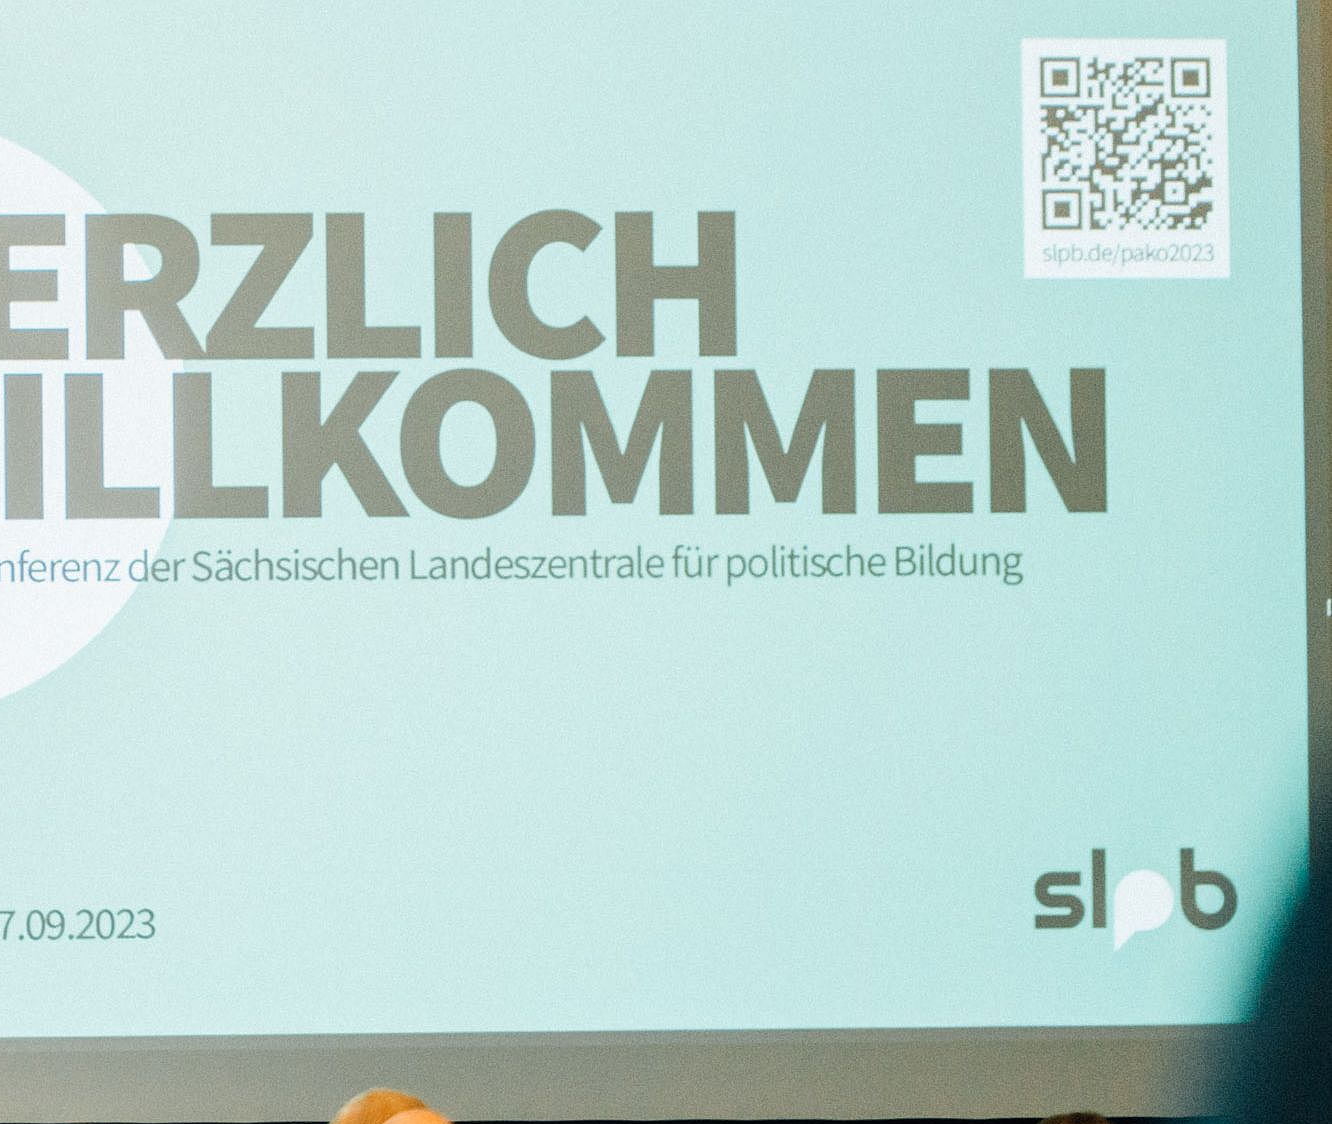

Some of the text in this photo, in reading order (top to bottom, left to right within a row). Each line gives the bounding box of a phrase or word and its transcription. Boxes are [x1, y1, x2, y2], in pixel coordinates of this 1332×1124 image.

[1042, 242, 1215, 267] slpb.de/pako2023
[127, 548, 186, 583] der
[192, 547, 400, 582] Sächsischen
[409, 545, 665, 580] Landeszentrale
[671, 545, 719, 579] für
[726, 544, 887, 587] politische
[894, 543, 1024, 586] Bildung
